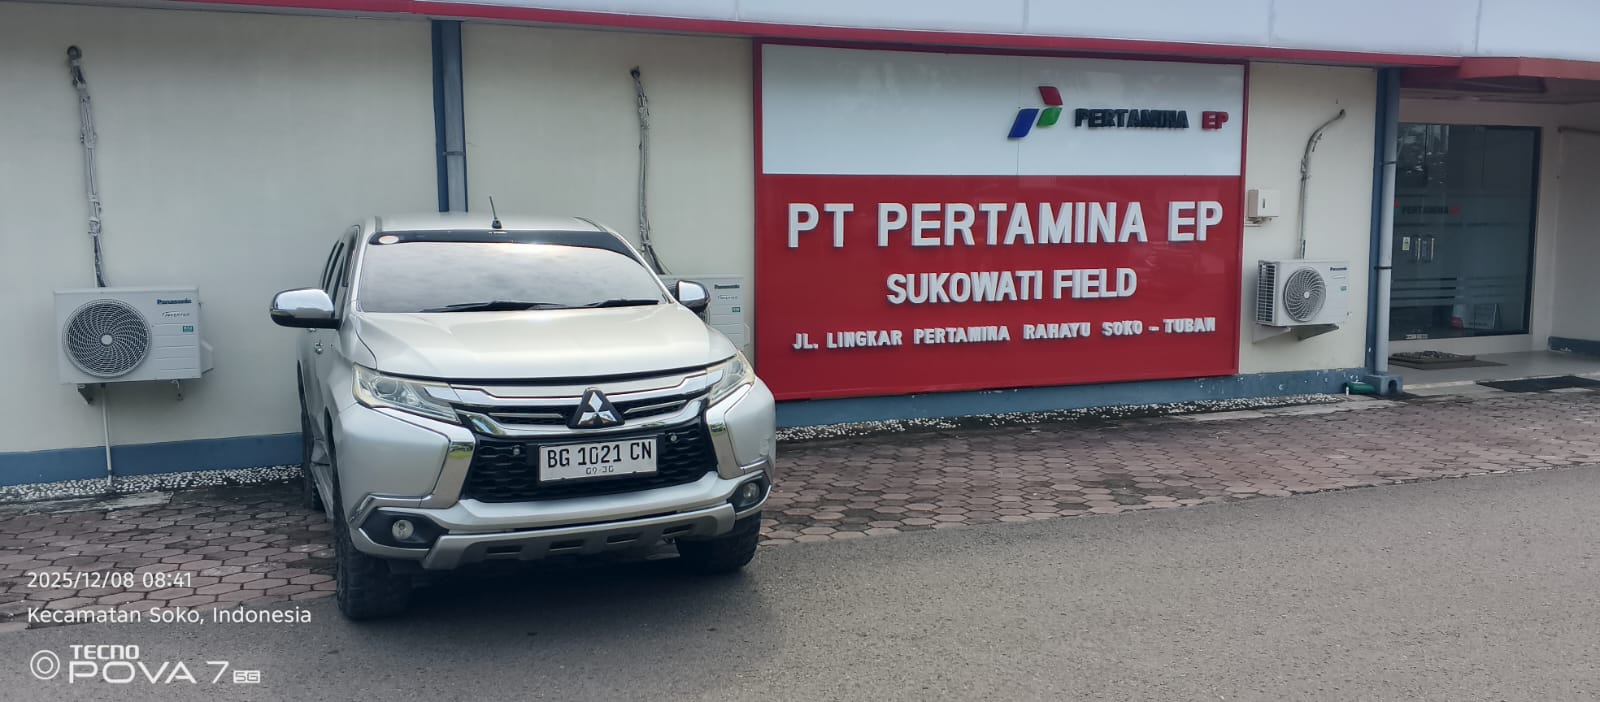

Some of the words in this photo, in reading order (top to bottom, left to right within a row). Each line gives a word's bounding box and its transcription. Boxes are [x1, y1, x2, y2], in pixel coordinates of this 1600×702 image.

[1075, 108, 1189, 129] PERTAMINA
[1202, 111, 1229, 129] EP
[788, 202, 854, 248] PT
[877, 201, 1148, 247] PERTAMINA
[1167, 200, 1223, 242] EP
[886, 269, 1043, 304] SUKOWATI
[1053, 267, 1137, 299] FIELD
[793, 332, 819, 350] JL.
[826, 330, 903, 349] LINGKAR
[913, 325, 1010, 344] PERTAMINA
[1023, 322, 1091, 340] RAHAYU
[1102, 320, 1143, 336] SOKO
[1163, 317, 1216, 333] TUBAN
[547, 448, 570, 468] BG
[577, 444, 622, 466] 1021
[630, 441, 652, 460] CN
